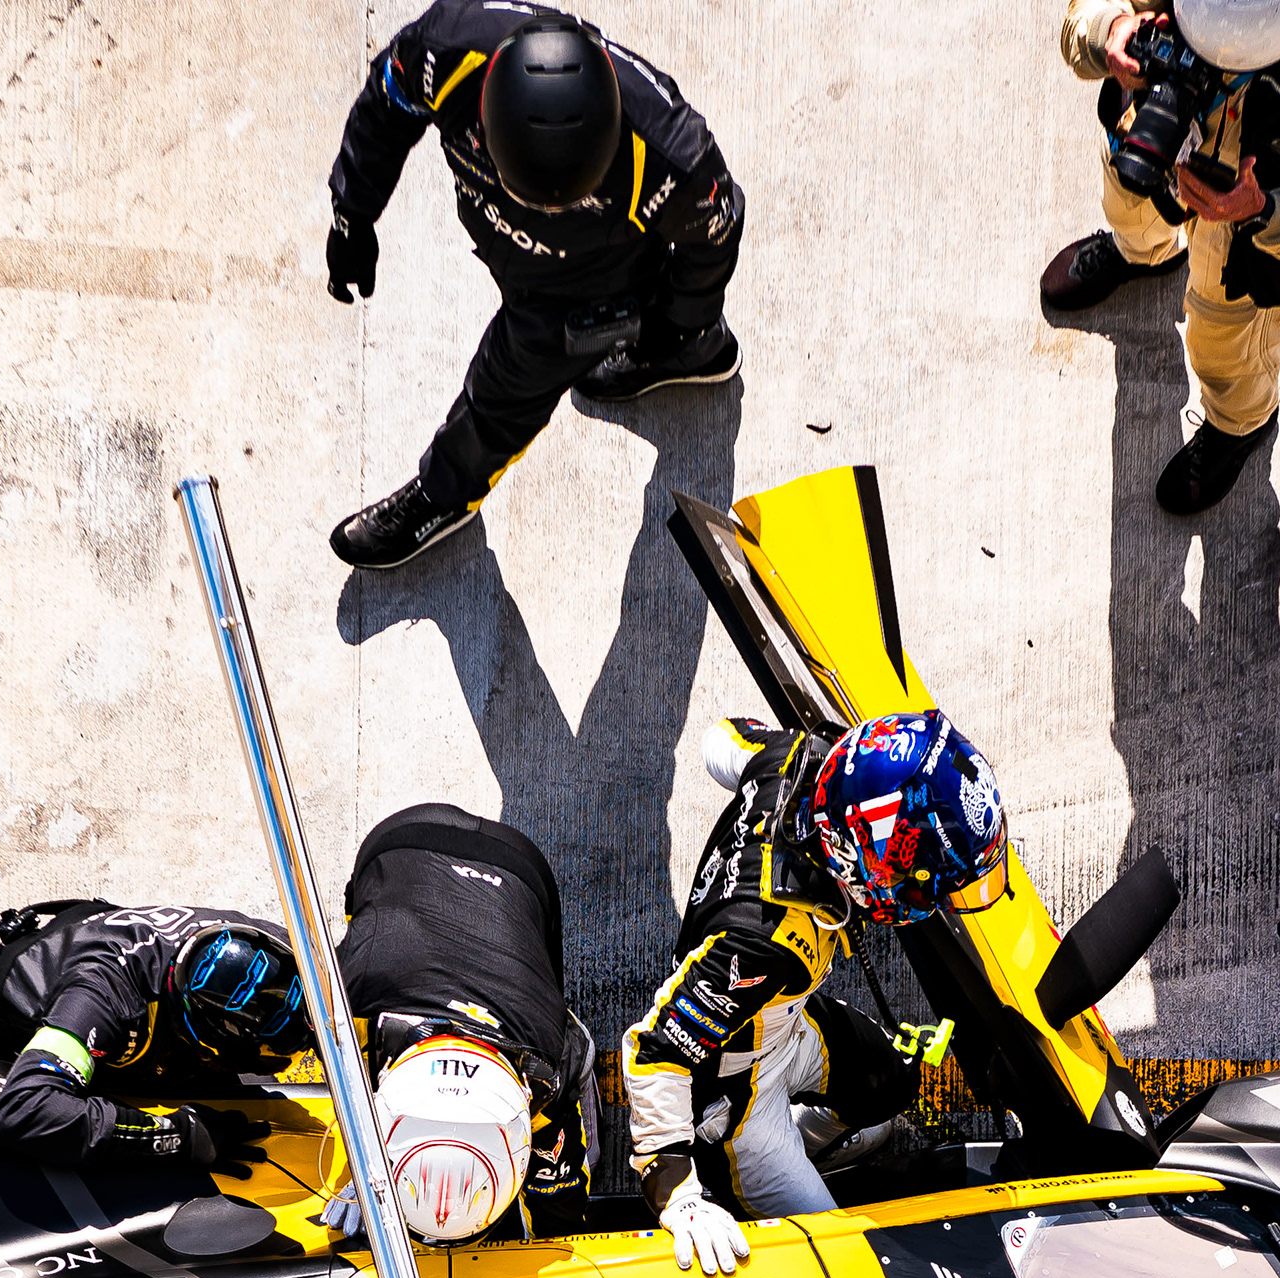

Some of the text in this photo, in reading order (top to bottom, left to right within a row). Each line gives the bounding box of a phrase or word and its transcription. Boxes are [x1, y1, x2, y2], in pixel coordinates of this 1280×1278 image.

[642, 173, 677, 219] HRX
[483, 202, 566, 259] SPOR
[786, 931, 816, 966] HRX
[697, 980, 740, 1013] WEC
[678, 998, 726, 1036] GOODYEAR
[665, 1017, 708, 1059] PROMAN
[153, 1137, 181, 1152] OMP
[34, 1247, 103, 1277] NC
